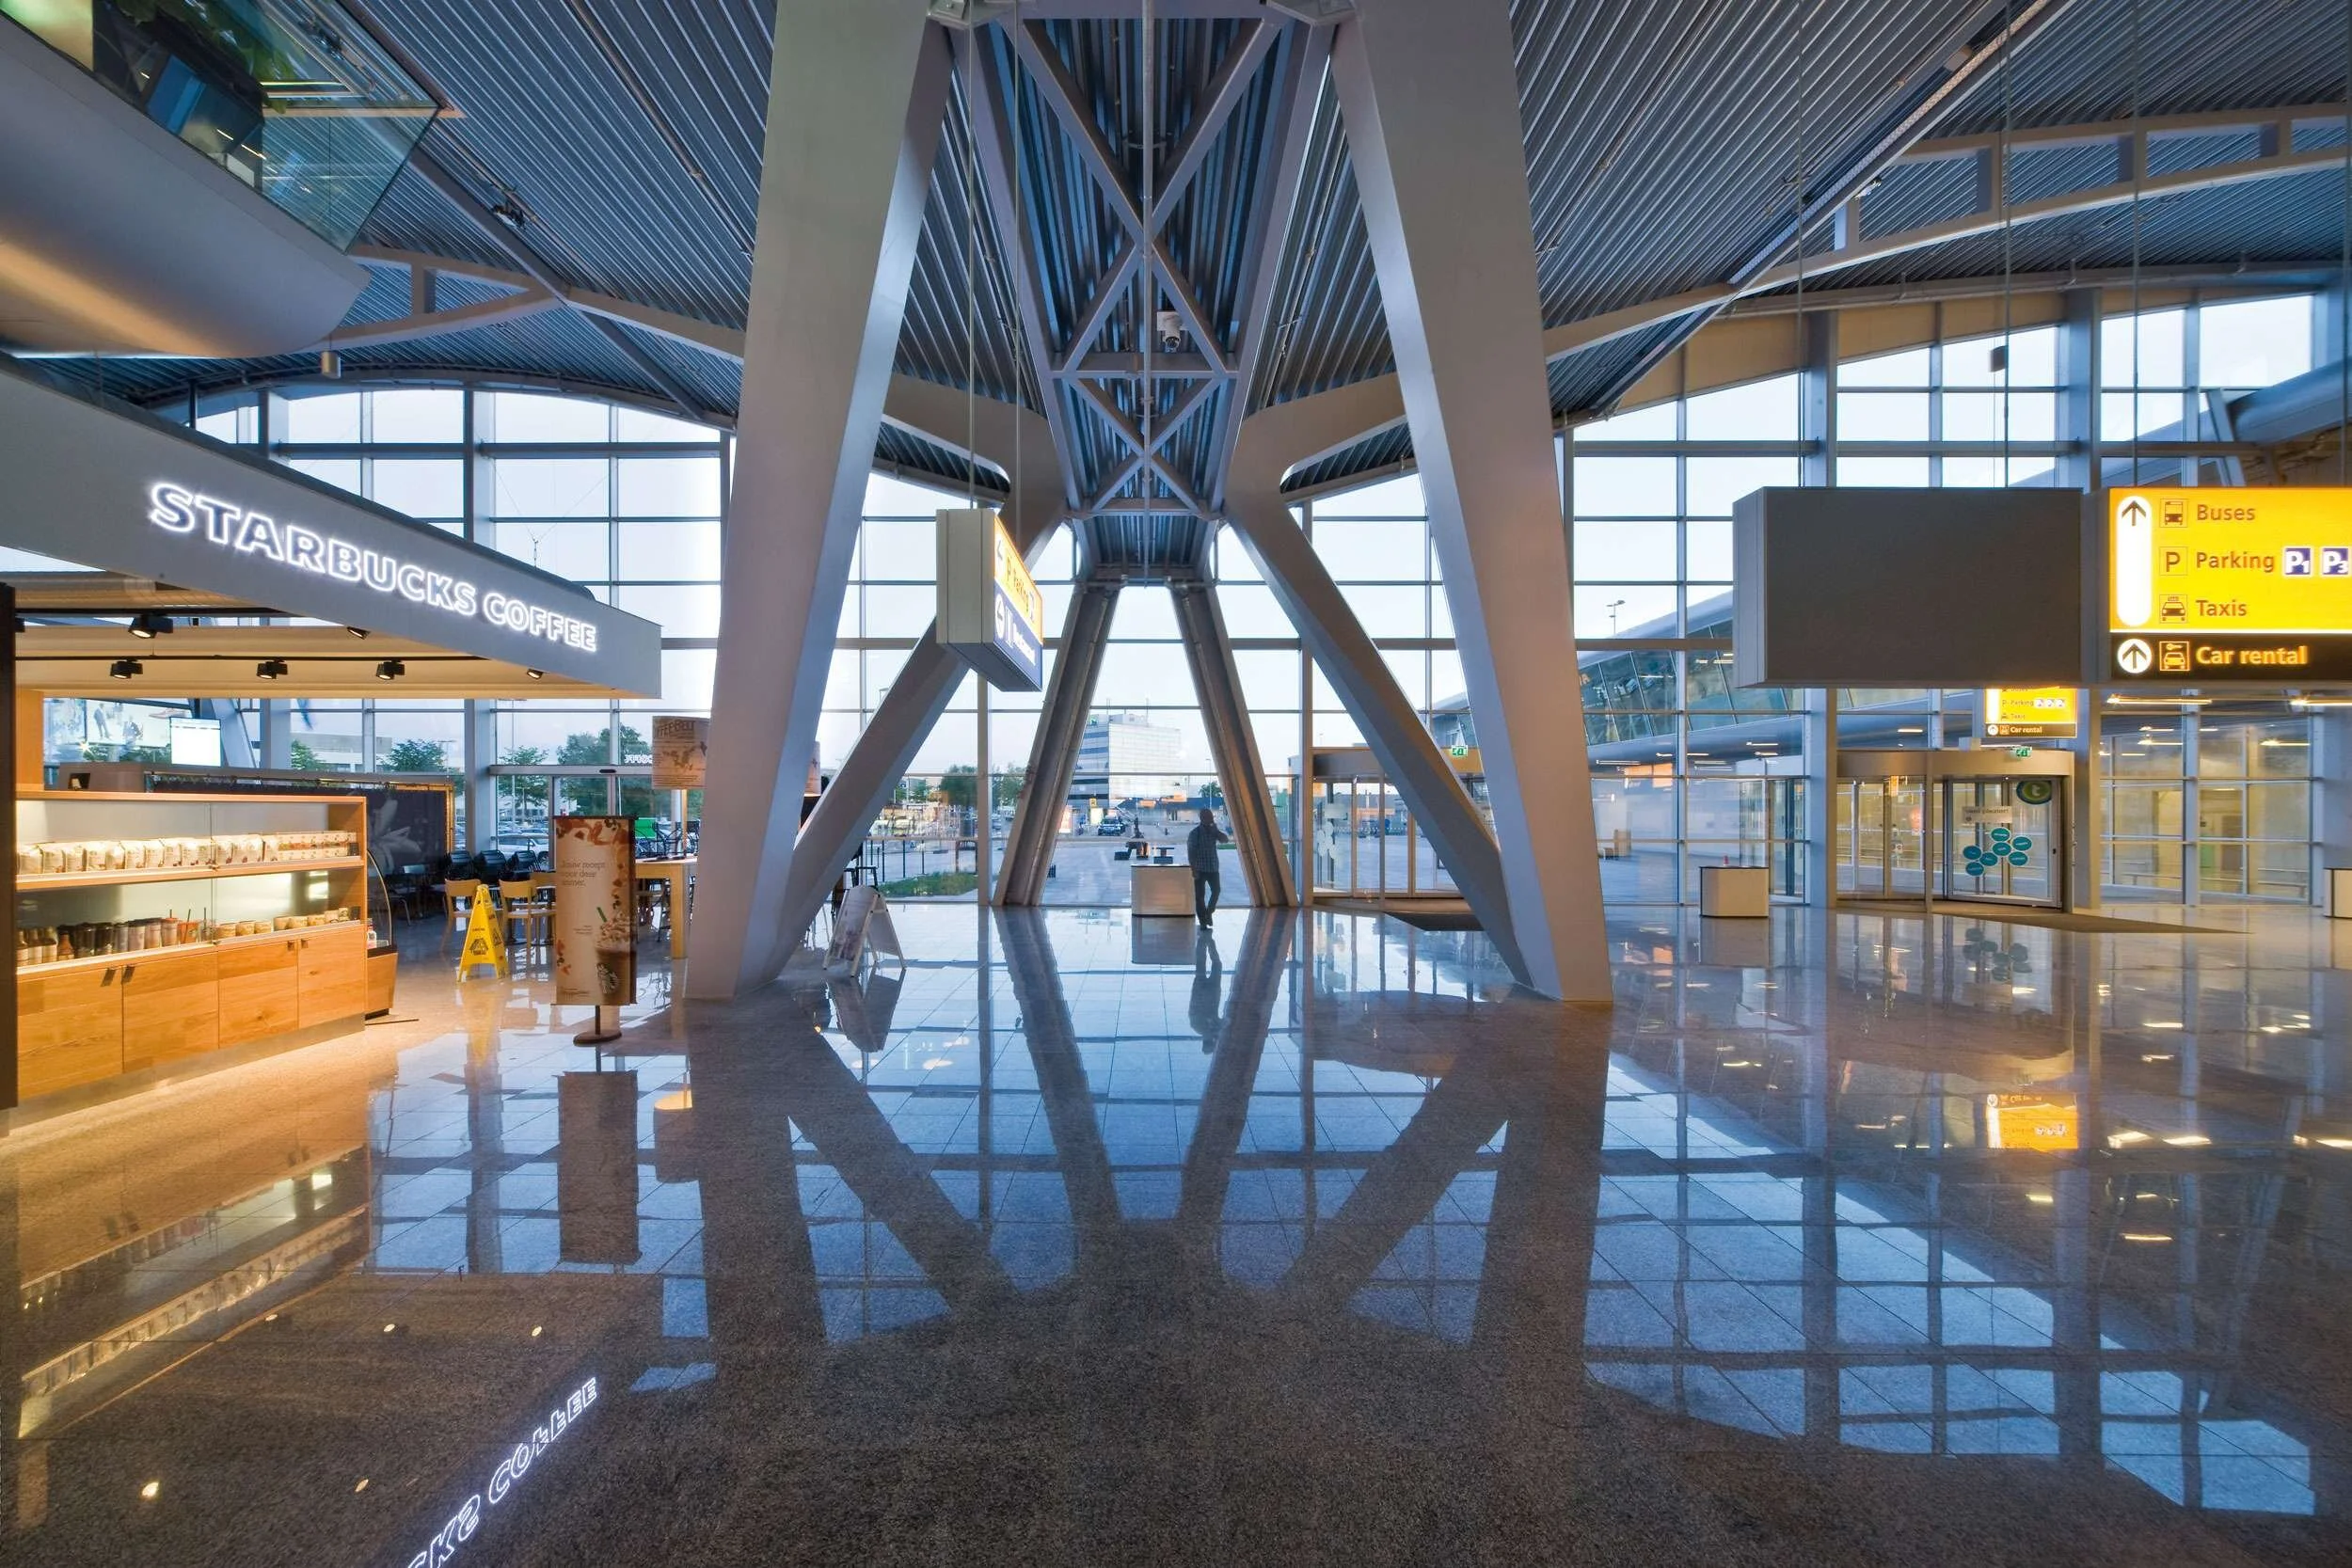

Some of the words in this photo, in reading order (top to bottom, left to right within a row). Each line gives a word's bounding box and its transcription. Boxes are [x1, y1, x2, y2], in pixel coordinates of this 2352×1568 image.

[2197, 503, 2256, 521] Buses
[149, 483, 477, 617] STARBUCKS
[483, 592, 597, 653] COFFEE
[2196, 551, 2275, 573] Parking
[2196, 599, 2248, 617] Taxis
[2196, 646, 2235, 664] Car
[2240, 645, 2308, 664] rental
[2010, 699, 2034, 707] Parking
